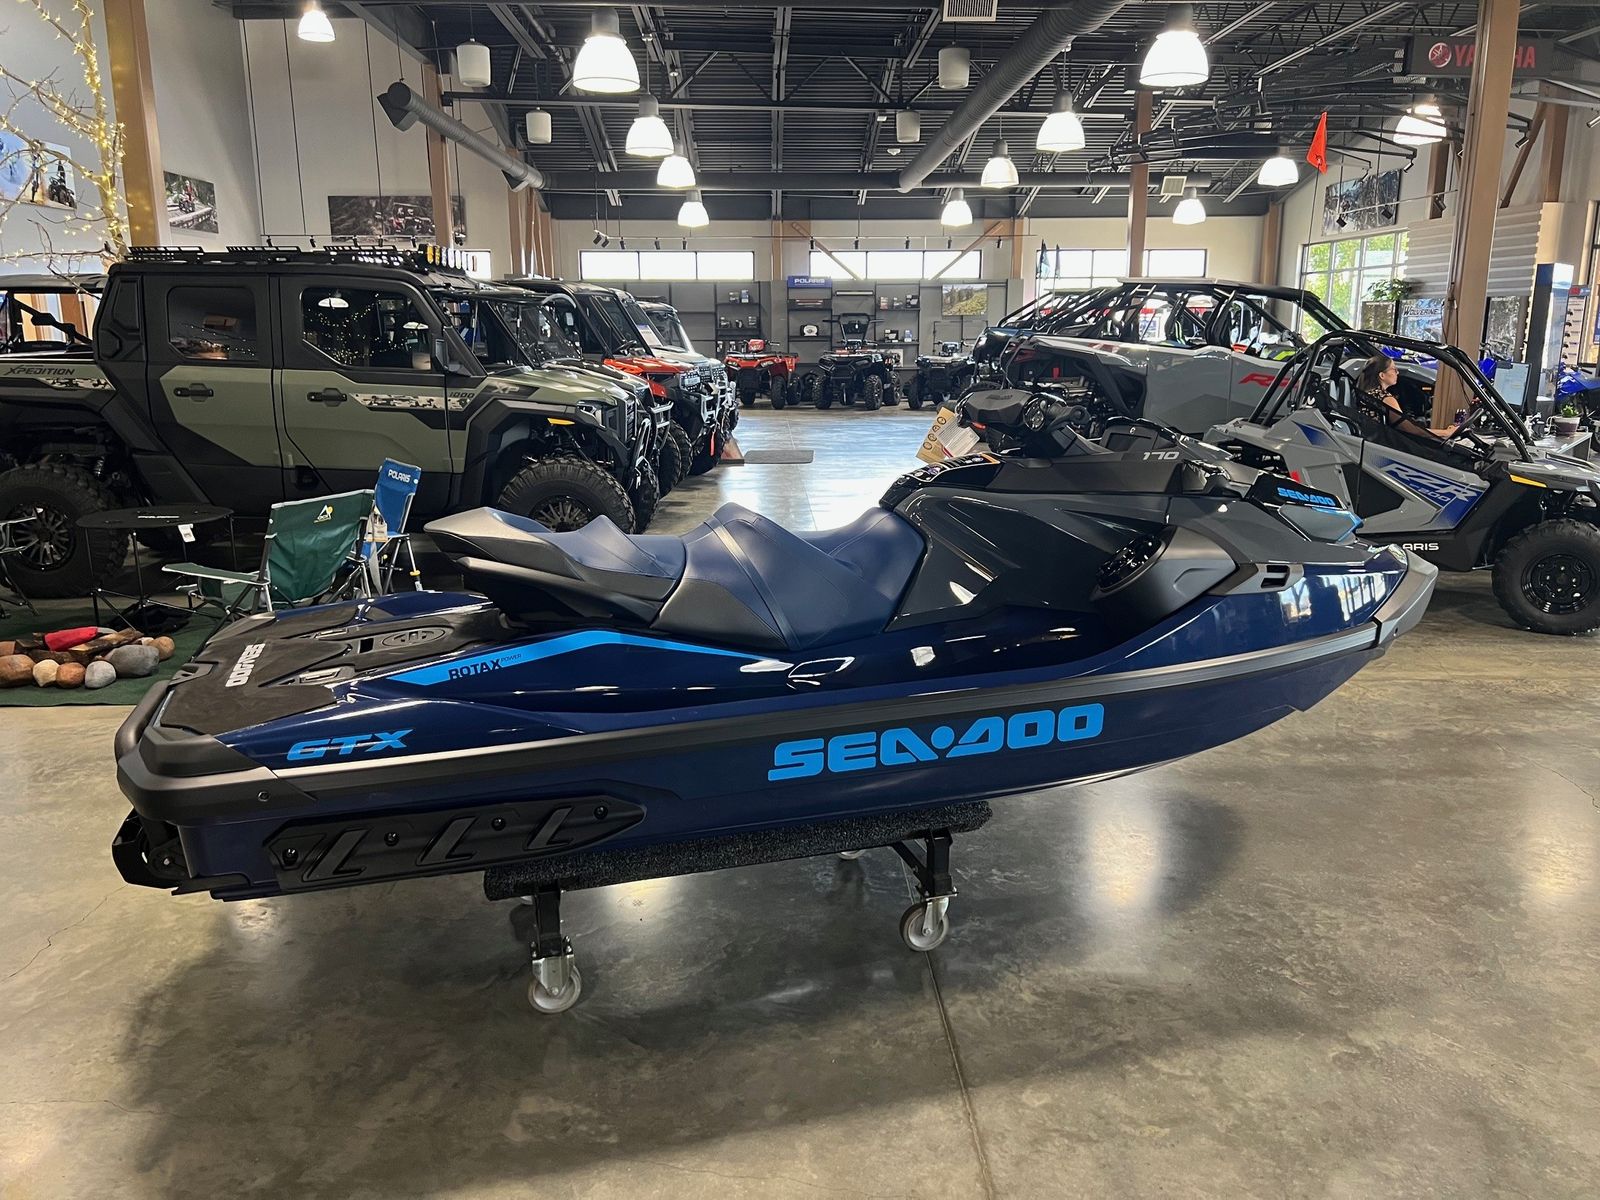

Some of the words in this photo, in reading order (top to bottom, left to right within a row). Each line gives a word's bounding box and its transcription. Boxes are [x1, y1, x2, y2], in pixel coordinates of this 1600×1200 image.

[4, 365, 75, 376] XPEDITION
[1143, 451, 1180, 461] 170
[388, 469, 411, 483] POLARIS
[1381, 463, 1478, 502] RZR
[448, 658, 502, 680] ROTAX
[501, 653, 522, 662] POWER
[286, 728, 414, 761] GTX
